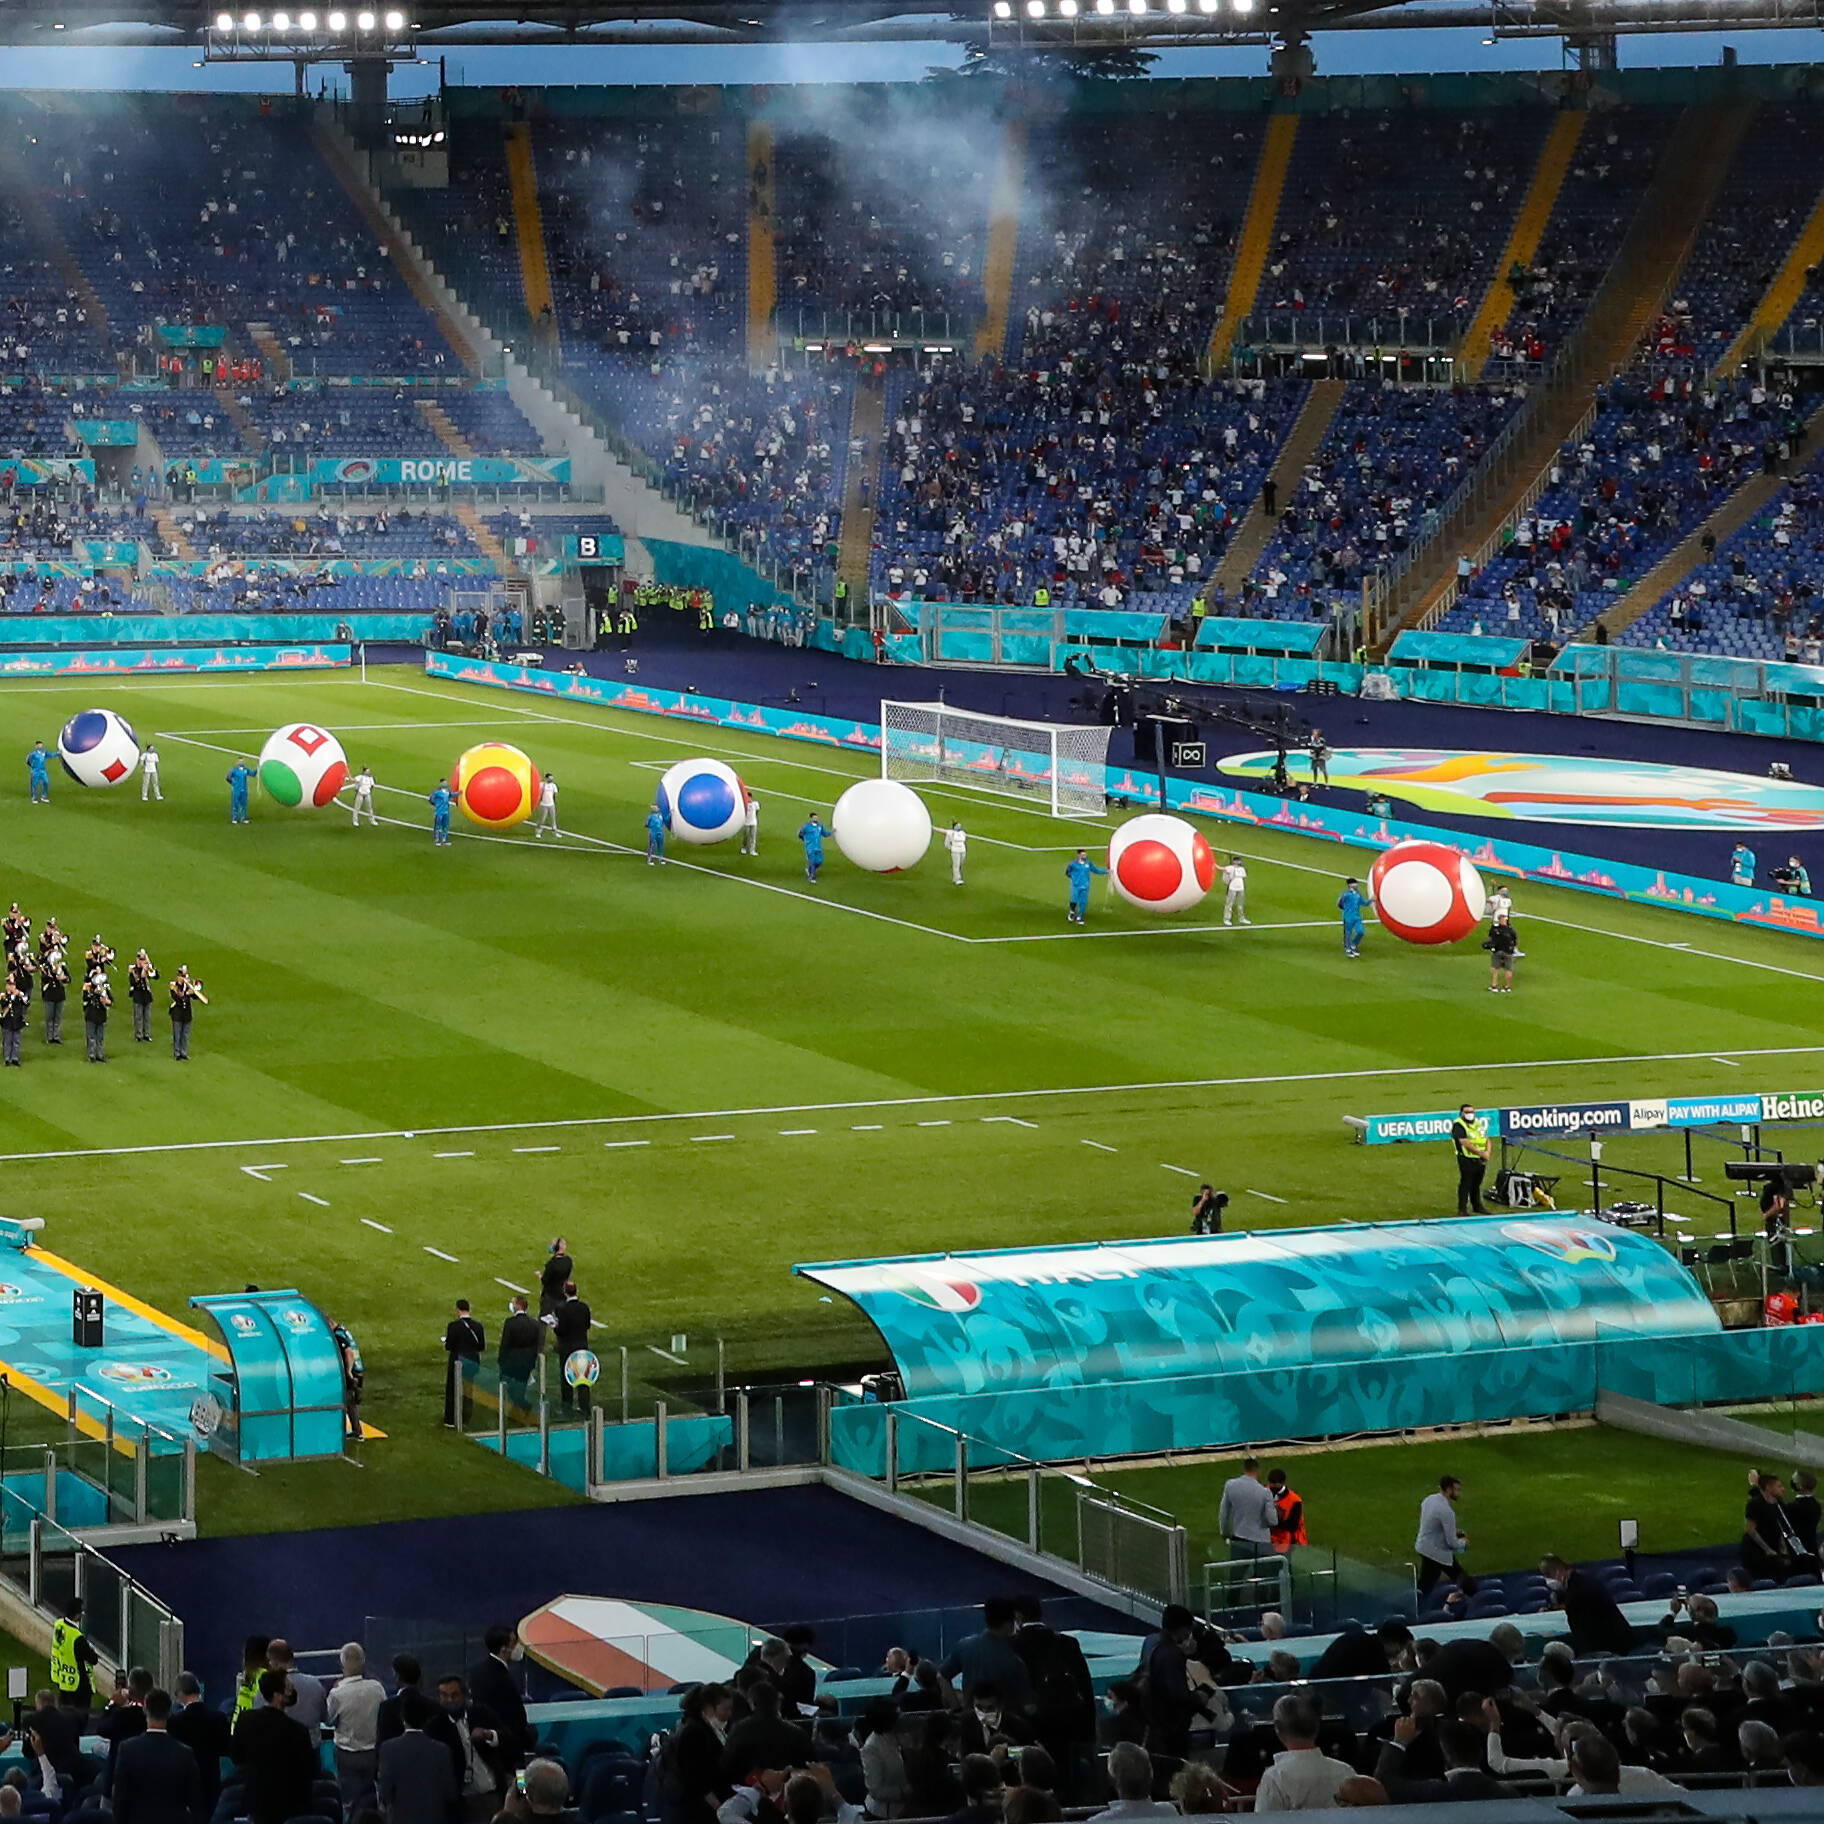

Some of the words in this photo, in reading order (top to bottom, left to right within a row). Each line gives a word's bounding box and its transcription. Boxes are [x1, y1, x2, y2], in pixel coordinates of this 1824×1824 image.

[401, 460, 472, 481] ROME
[580, 537, 596, 556] B
[1509, 1107, 1622, 1131] Booking.com
[1633, 1107, 1665, 1121] Alipay
[1668, 1106, 1690, 1120] PAY
[1690, 1105, 1720, 1119] WITH
[1720, 1102, 1759, 1118] ALIPAY
[1377, 1120, 1413, 1138] UEFA
[1415, 1119, 1453, 1137] EURO
